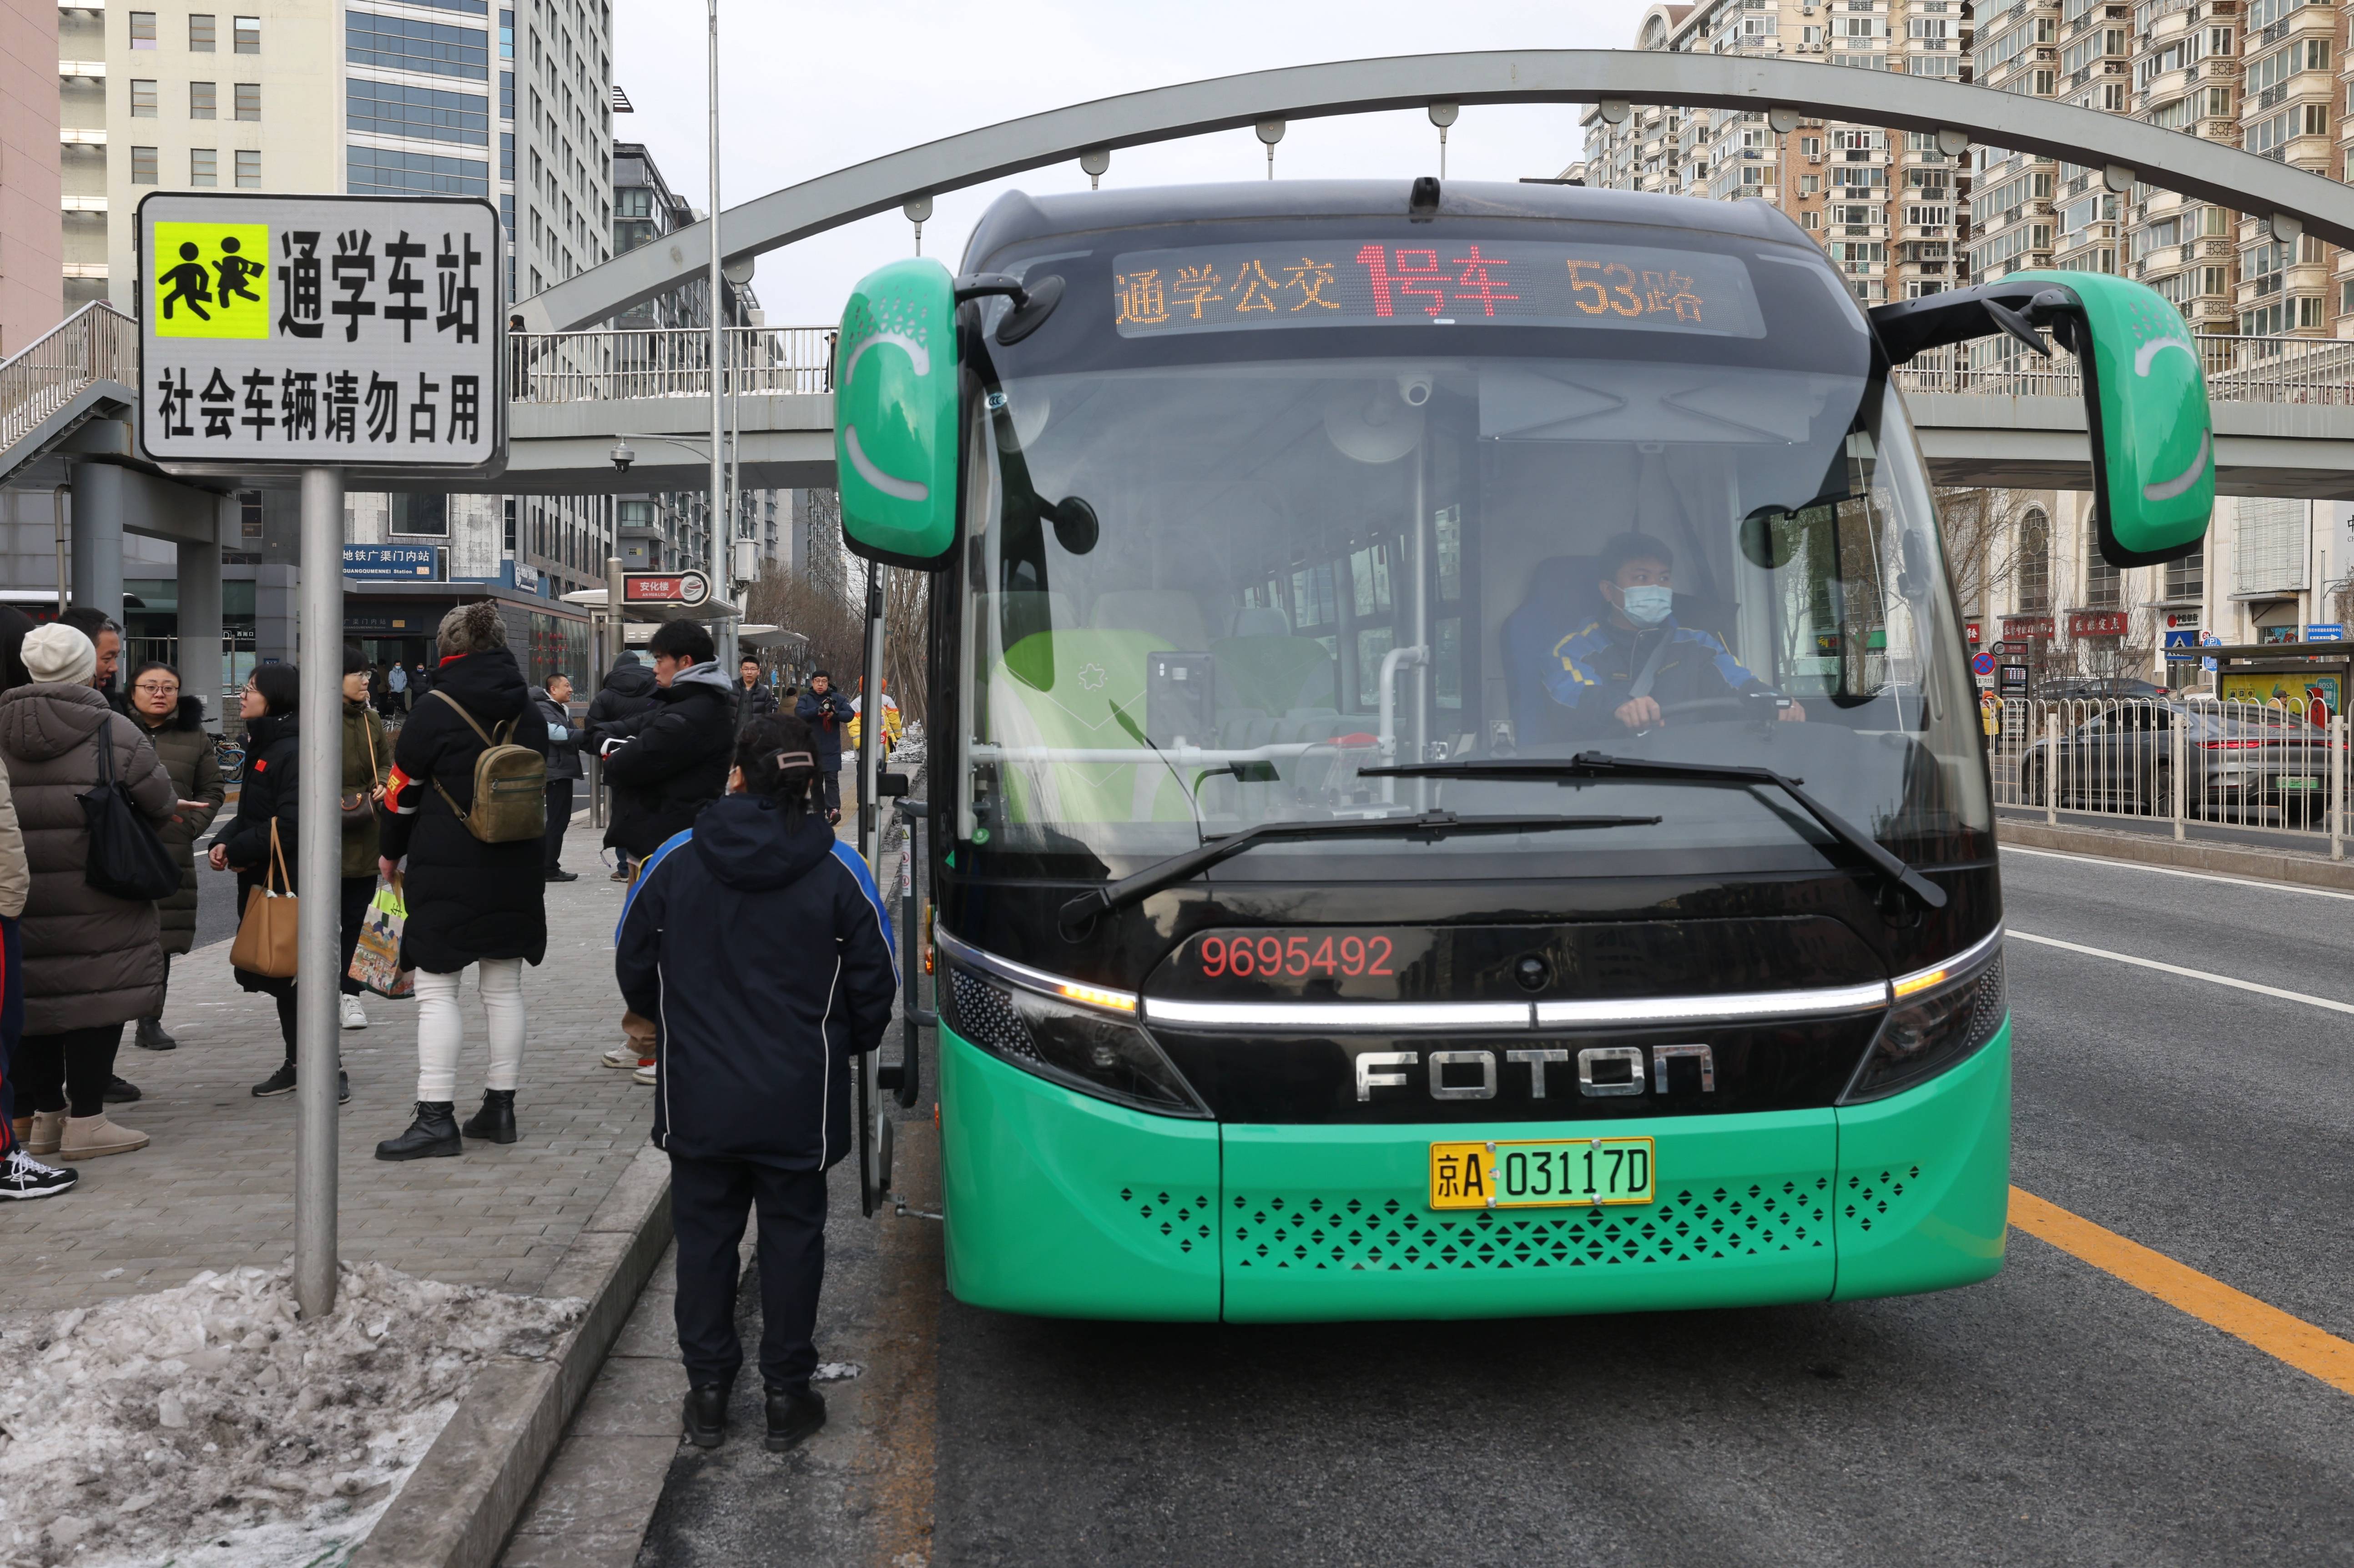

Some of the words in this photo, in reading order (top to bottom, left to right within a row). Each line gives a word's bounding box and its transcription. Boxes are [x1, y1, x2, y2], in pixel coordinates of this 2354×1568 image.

[277, 229, 481, 344] 通学车站
[1116, 257, 1340, 325] 通学公交
[1356, 245, 1519, 317] 1号车
[1566, 259, 1704, 322] 53路
[158, 367, 479, 446] 社会车辆请勿占用
[343, 549, 430, 562] 地铁广渠门内站
[640, 582, 669, 592] 安化楼
[1201, 936, 1393, 977] 9695492
[1356, 1044, 1715, 1102] FOTON
